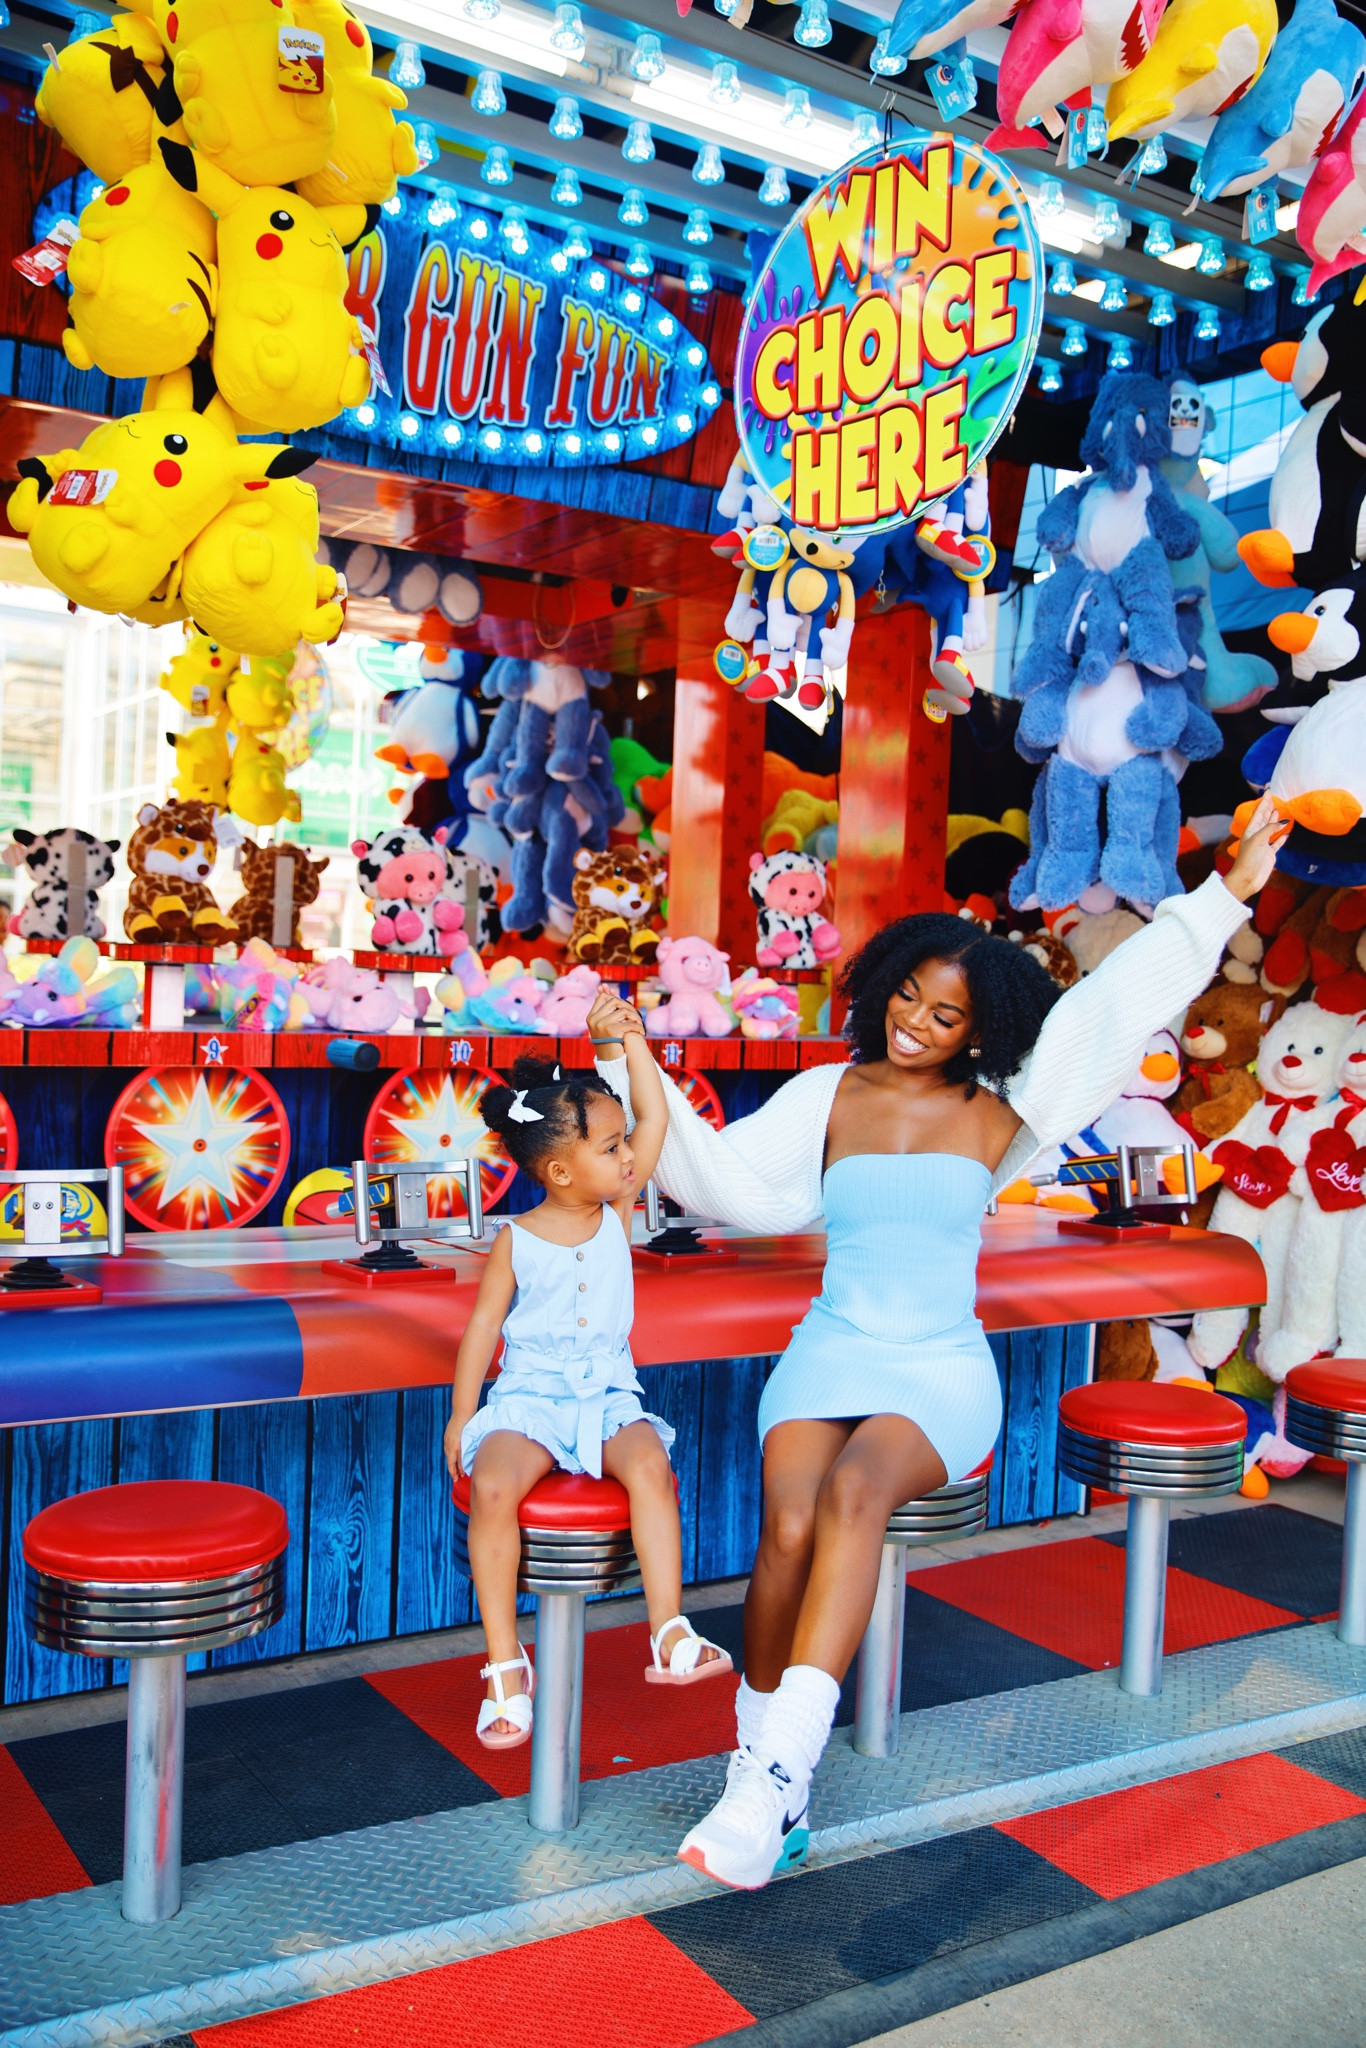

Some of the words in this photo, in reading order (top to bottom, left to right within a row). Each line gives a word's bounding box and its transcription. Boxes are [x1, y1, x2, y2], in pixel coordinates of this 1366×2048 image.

[802, 139, 953, 299] WIN
[403, 240, 547, 428] GUN
[545, 294, 670, 428] FUN
[751, 244, 1017, 421] CHOICE
[791, 375, 968, 530] HERE
[208, 1039, 220, 1060] 9
[451, 1041, 471, 1062] 10
[1316, 1161, 1362, 1192] Love
